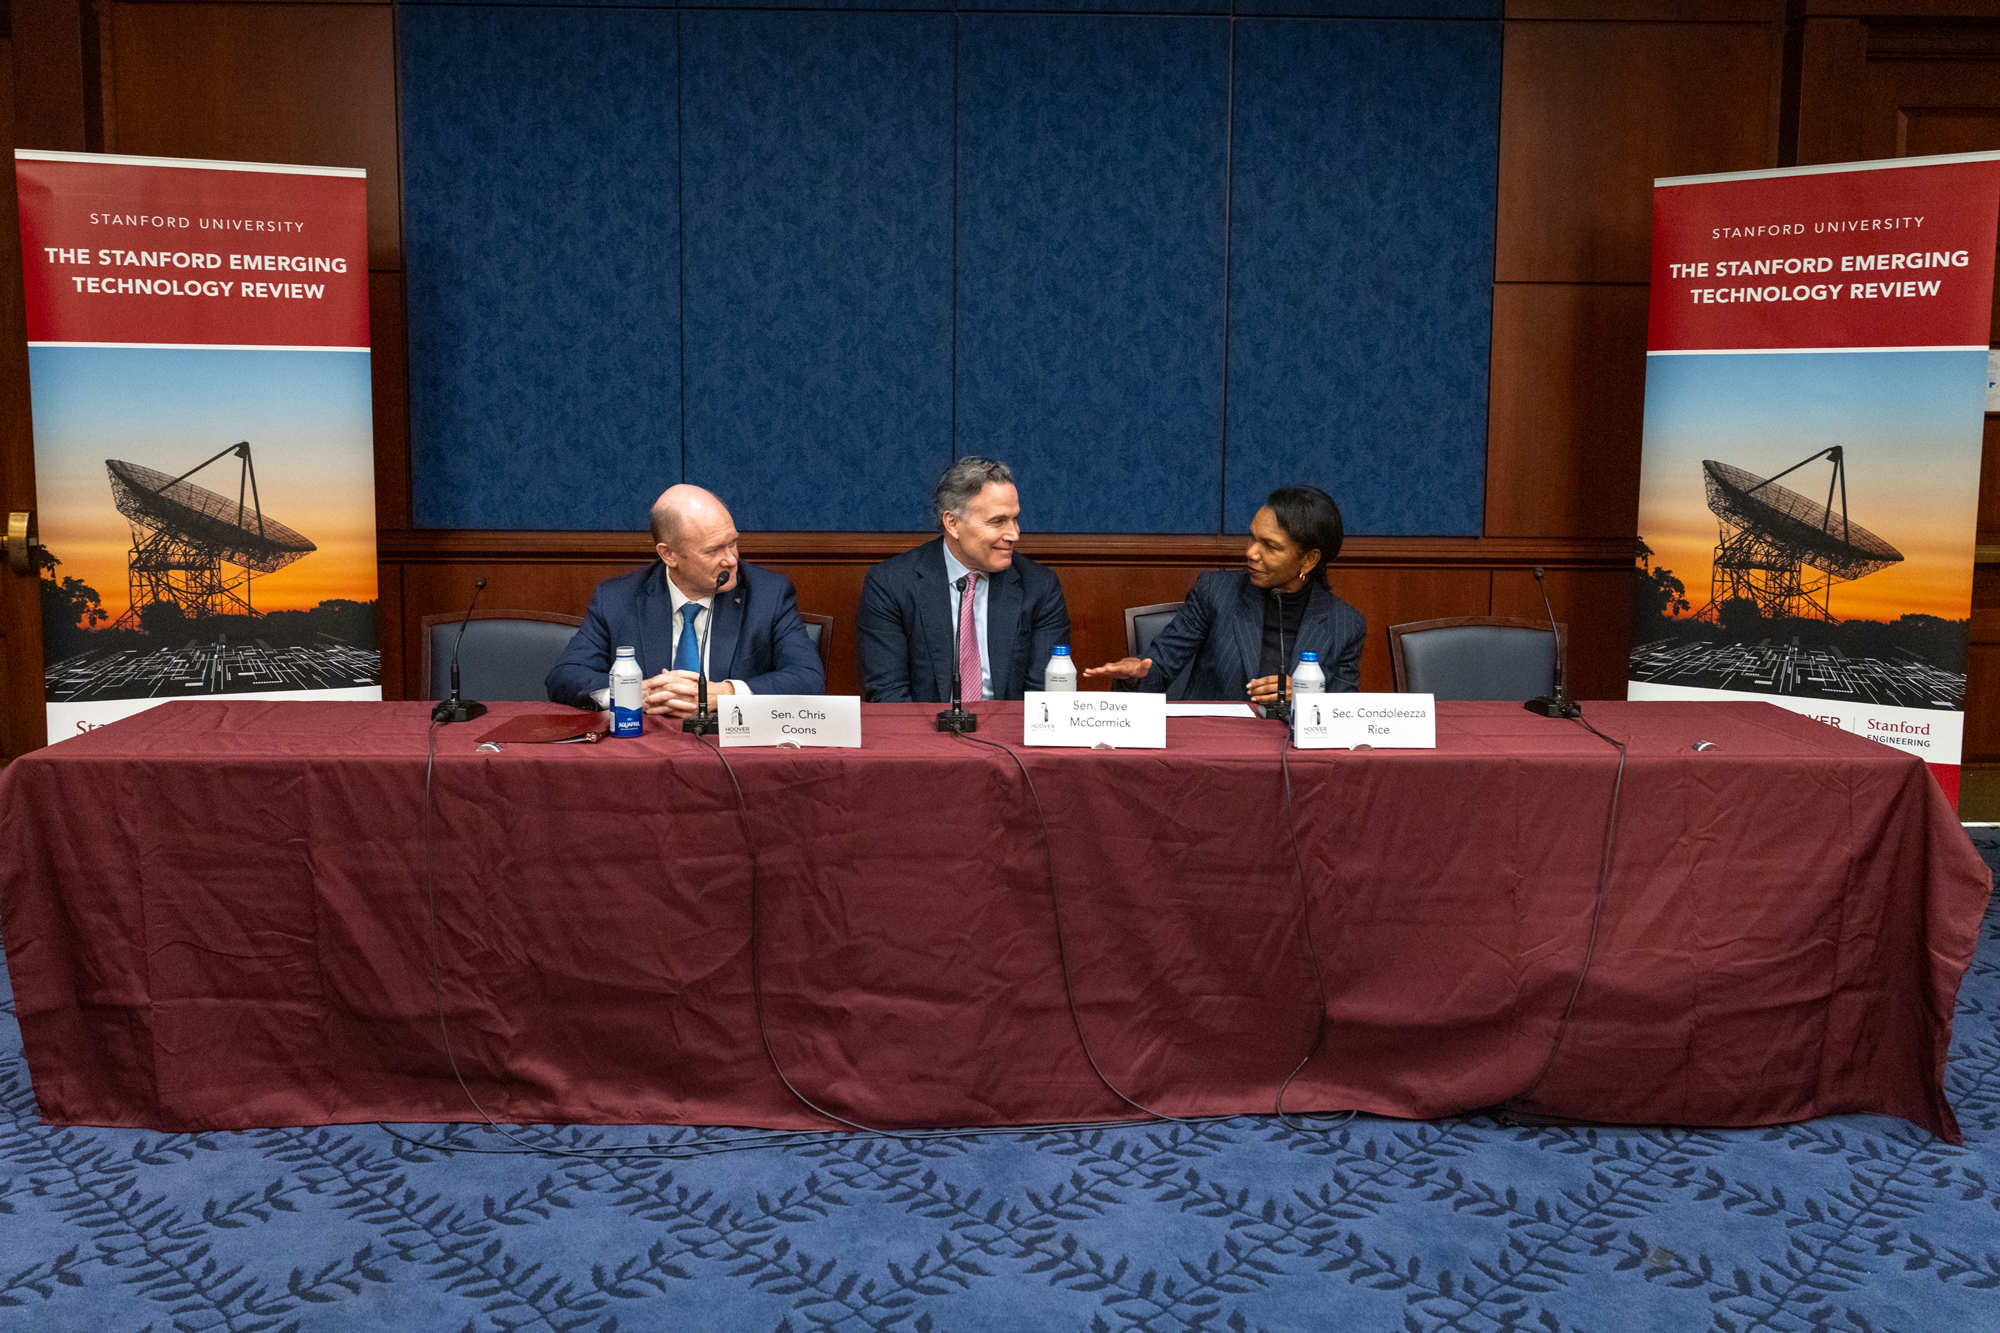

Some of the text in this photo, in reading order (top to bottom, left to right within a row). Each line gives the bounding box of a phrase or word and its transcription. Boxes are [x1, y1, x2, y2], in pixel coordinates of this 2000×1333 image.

[90, 213, 305, 233] STANFORD UNIVERSITY
[1712, 216, 1926, 240] STANFORD UNIVERSITY
[44, 247, 348, 273] THE STANFORD EMERGING
[1669, 250, 1970, 279] THE STANFORD EMERGING
[72, 276, 325, 300] TECHNOLOGY REVIEW
[1690, 280, 1942, 304] TECHNOLOGY REVIEW
[1073, 700, 1128, 711] Sen. Dave
[1332, 708, 1426, 718] Sec. Condoleezza
[771, 709, 826, 720] Sen. Chris
[1069, 717, 1131, 728] McCormick
[781, 724, 817, 735] Coons
[1367, 724, 1391, 735] Rice
[1867, 718, 1931, 736] Stanford
[1867, 734, 1931, 748] ENGINEERING
